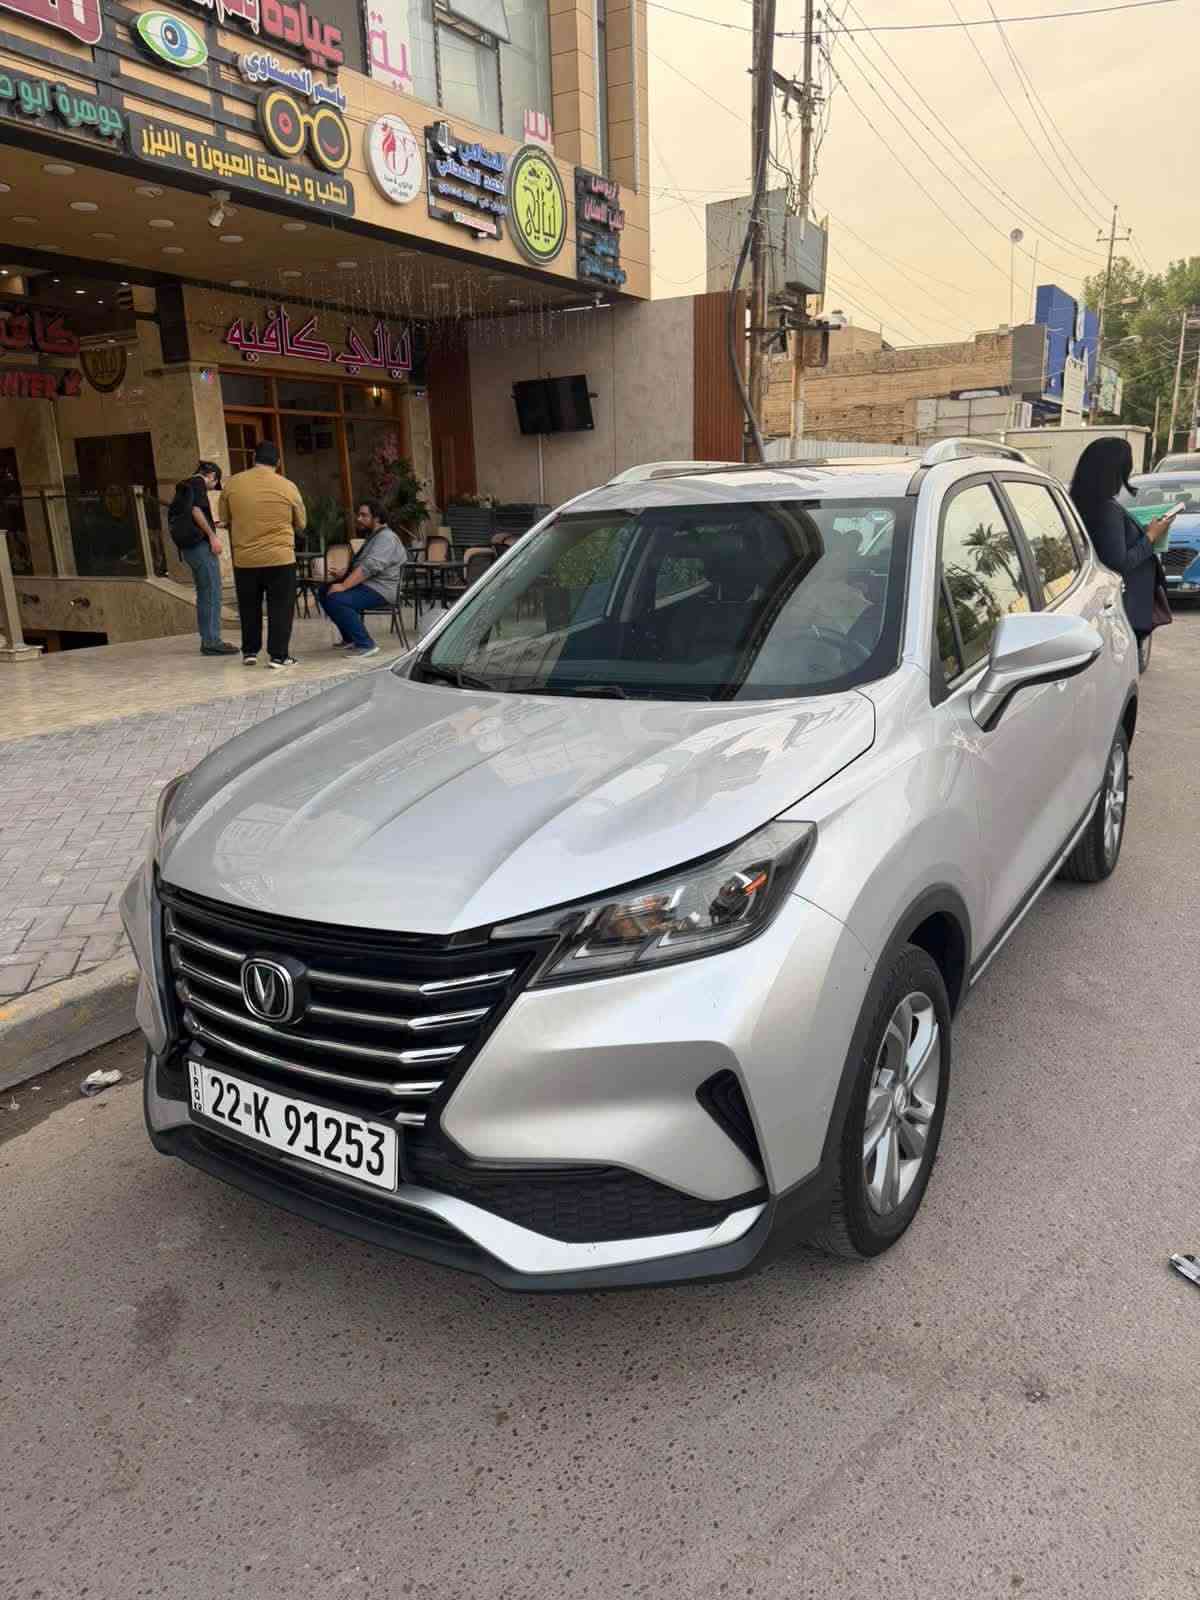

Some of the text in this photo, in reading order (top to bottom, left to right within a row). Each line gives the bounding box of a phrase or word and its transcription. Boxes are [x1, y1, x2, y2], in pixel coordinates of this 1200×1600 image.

[56, 83, 124, 137] جوهرة
[184, 140, 198, 168] و
[200, 139, 254, 178] العيون
[255, 155, 301, 195] جراحة
[225, 302, 413, 379] ليالي كافيه
[284, 1104, 386, 1177] 91253
